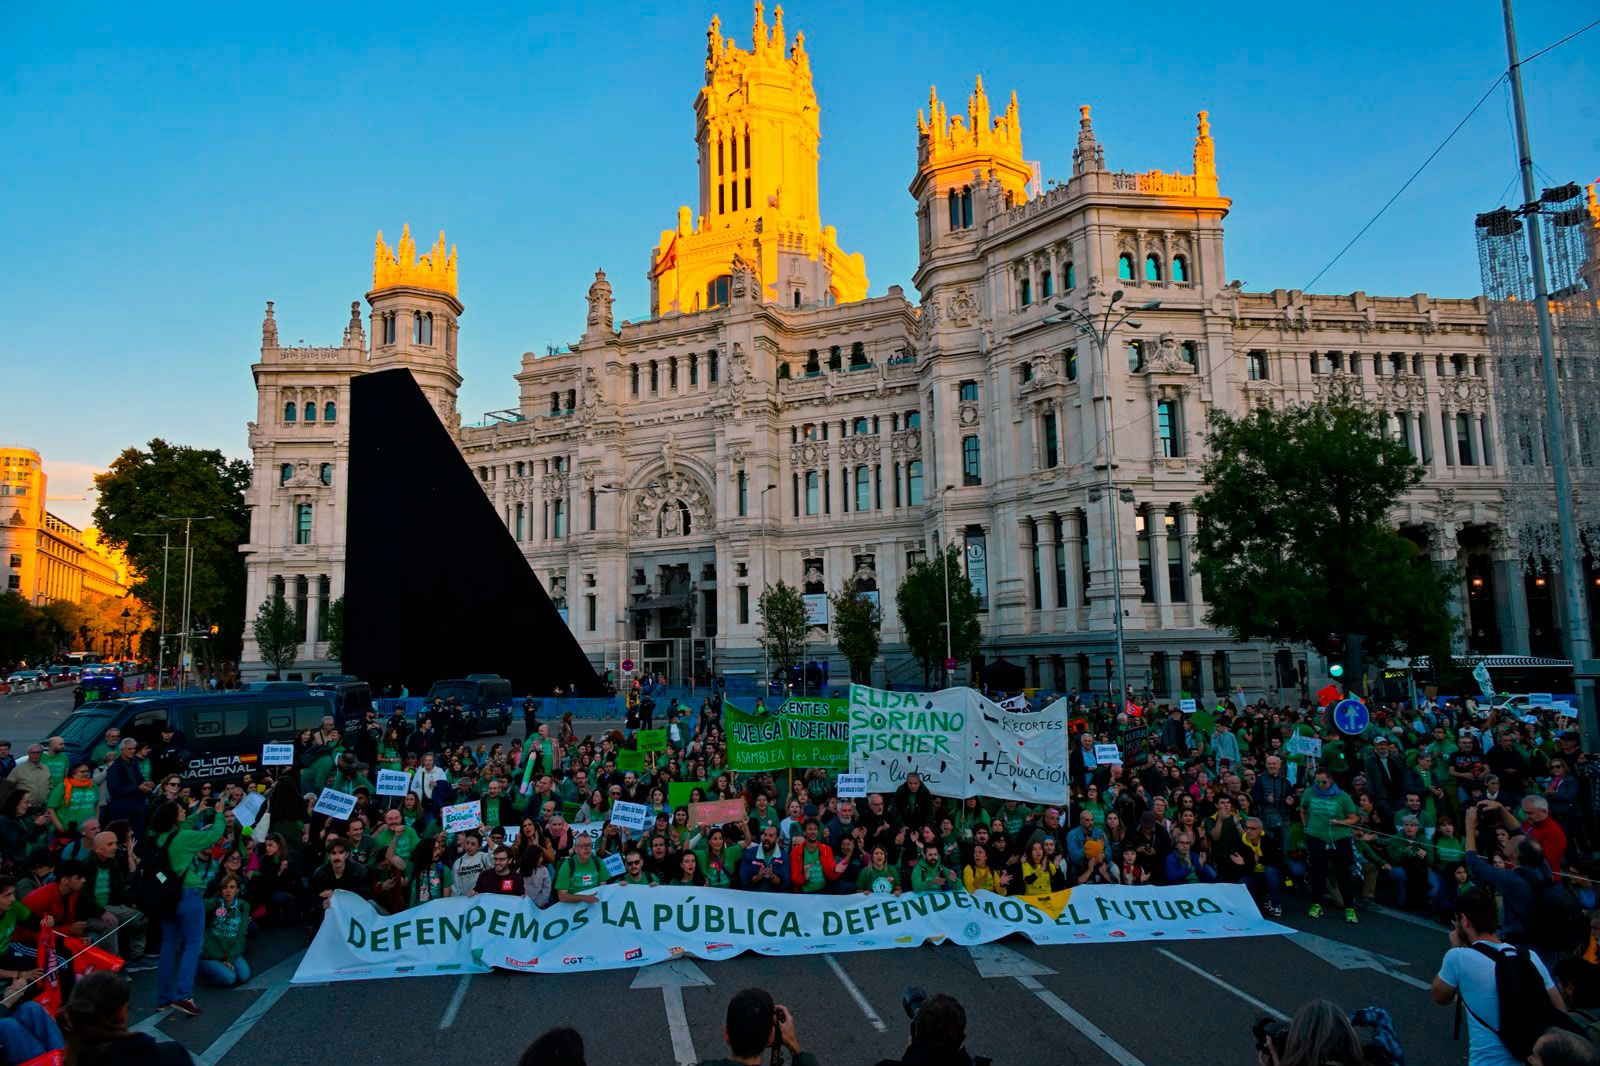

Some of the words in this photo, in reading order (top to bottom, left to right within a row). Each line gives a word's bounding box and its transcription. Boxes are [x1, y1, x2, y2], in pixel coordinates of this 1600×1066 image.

[732, 720, 783, 744] HUELGA
[788, 720, 849, 741] NDEFINID
[851, 711, 964, 733] SORIANO
[851, 734, 951, 754] FISCHER
[188, 755, 241, 769] OLICIA
[736, 747, 786, 764] ASAMBLEA
[180, 764, 256, 779] NACIONAL
[889, 758, 941, 784] luha
[347, 905, 589, 952] DEFENDEMOS
[601, 900, 642, 930] LA
[653, 896, 811, 937] PÚBLICA.
[823, 891, 1044, 937] DEFENDEMOS
[1094, 897, 1234, 921] FUTURO.
[562, 957, 584, 965] CGT
